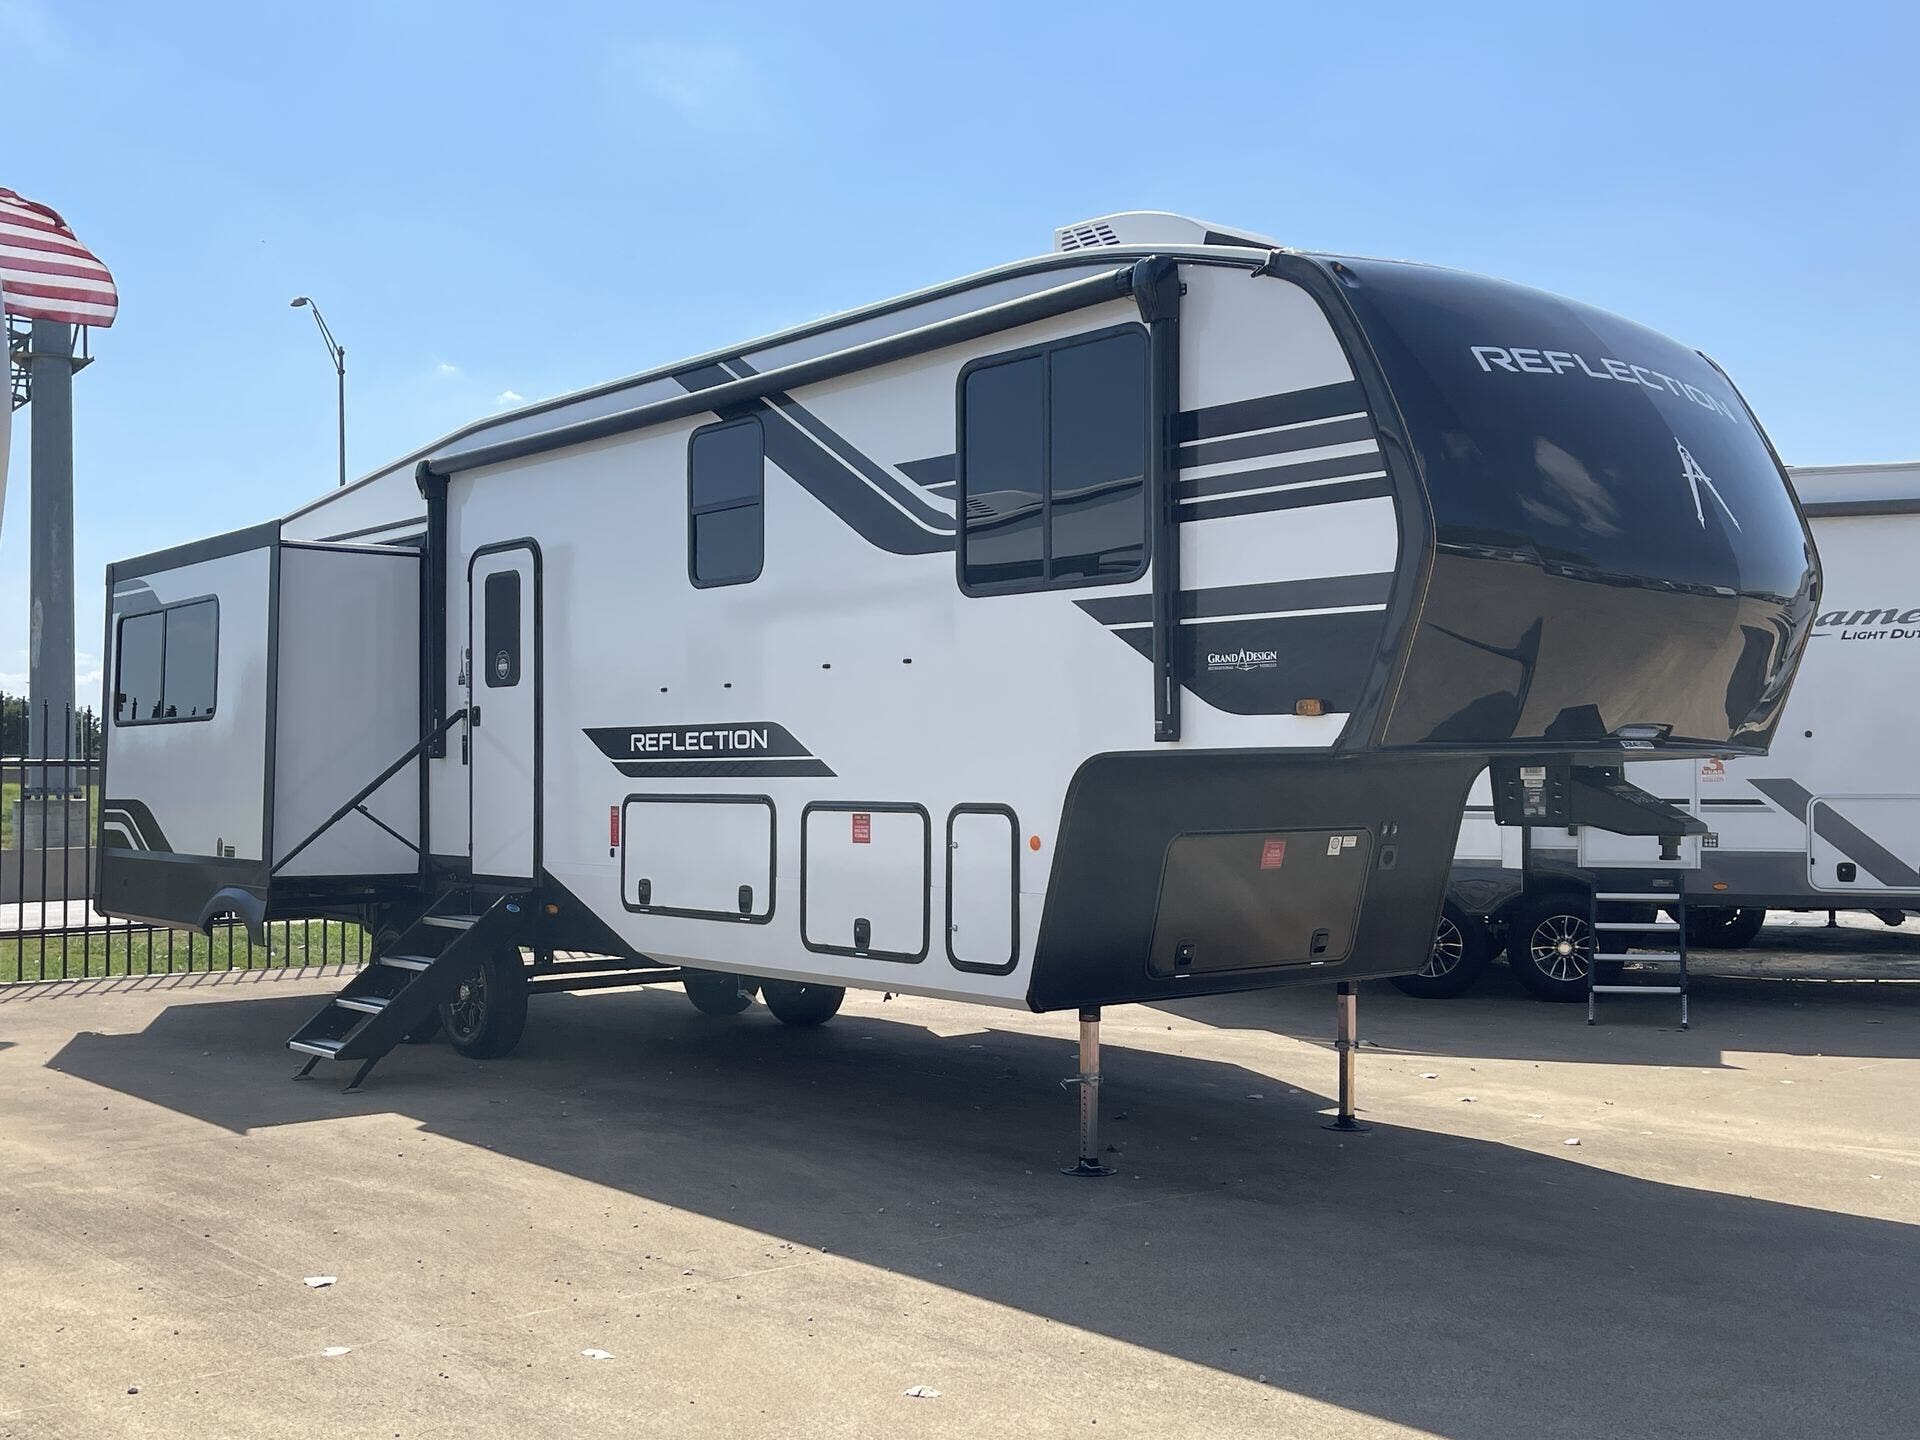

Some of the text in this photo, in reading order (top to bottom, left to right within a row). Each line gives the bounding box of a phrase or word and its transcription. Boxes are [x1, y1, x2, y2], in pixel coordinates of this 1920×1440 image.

[1470, 346, 1738, 423] REFLECTION
[1814, 608, 1920, 627] ame
[1841, 630, 1889, 640] LIGHT
[1207, 651, 1277, 664] GRAND DESIGN
[630, 729, 768, 752] REFLECTION
